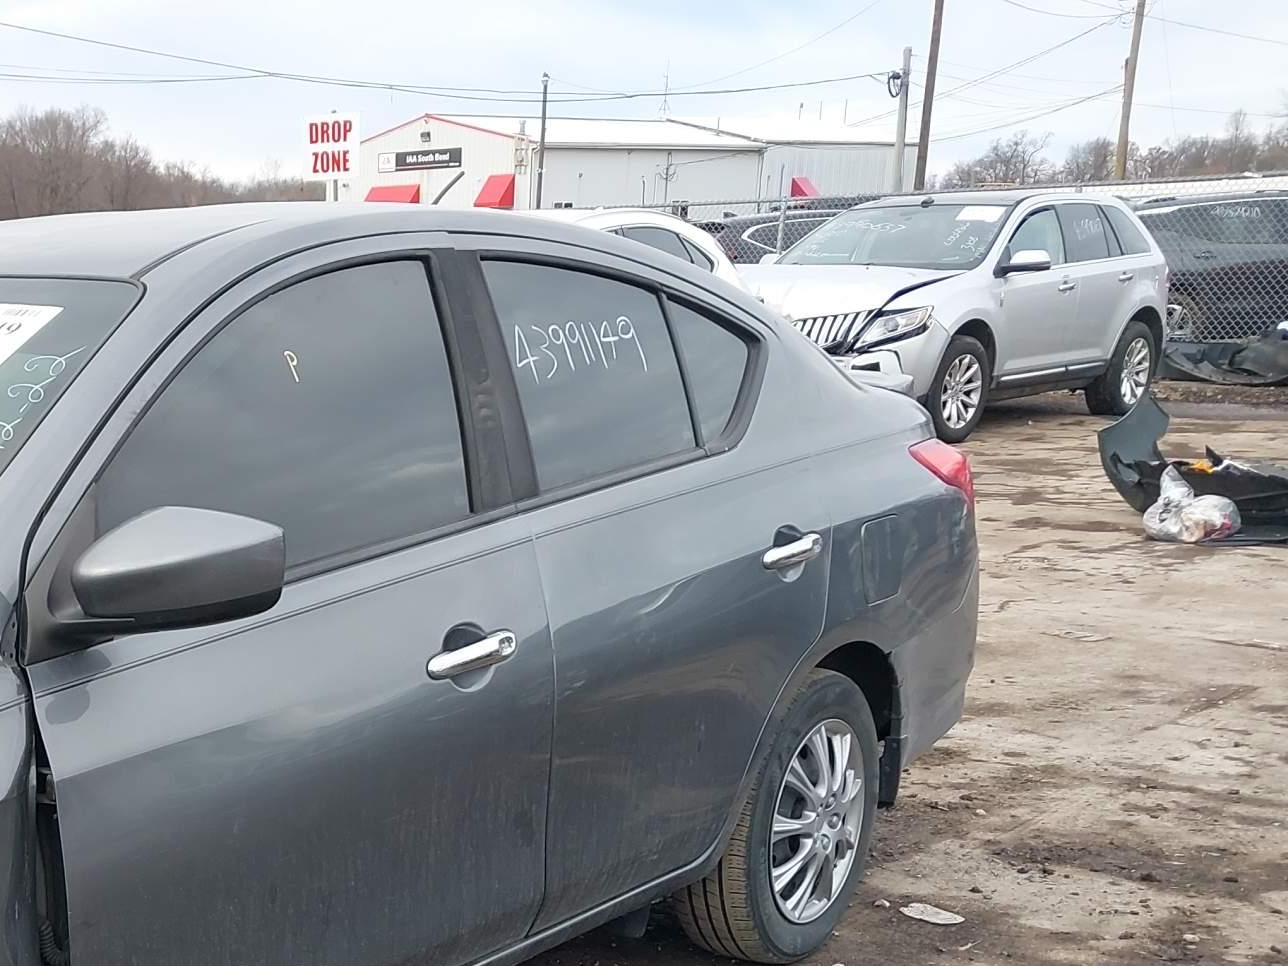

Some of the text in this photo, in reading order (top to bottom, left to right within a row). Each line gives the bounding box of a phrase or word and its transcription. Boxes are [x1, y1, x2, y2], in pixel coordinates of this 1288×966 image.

[309, 120, 352, 144] DROP
[312, 149, 350, 173] ZONE
[514, 316, 648, 384] 43991149
[284, 350, 298, 383] P
